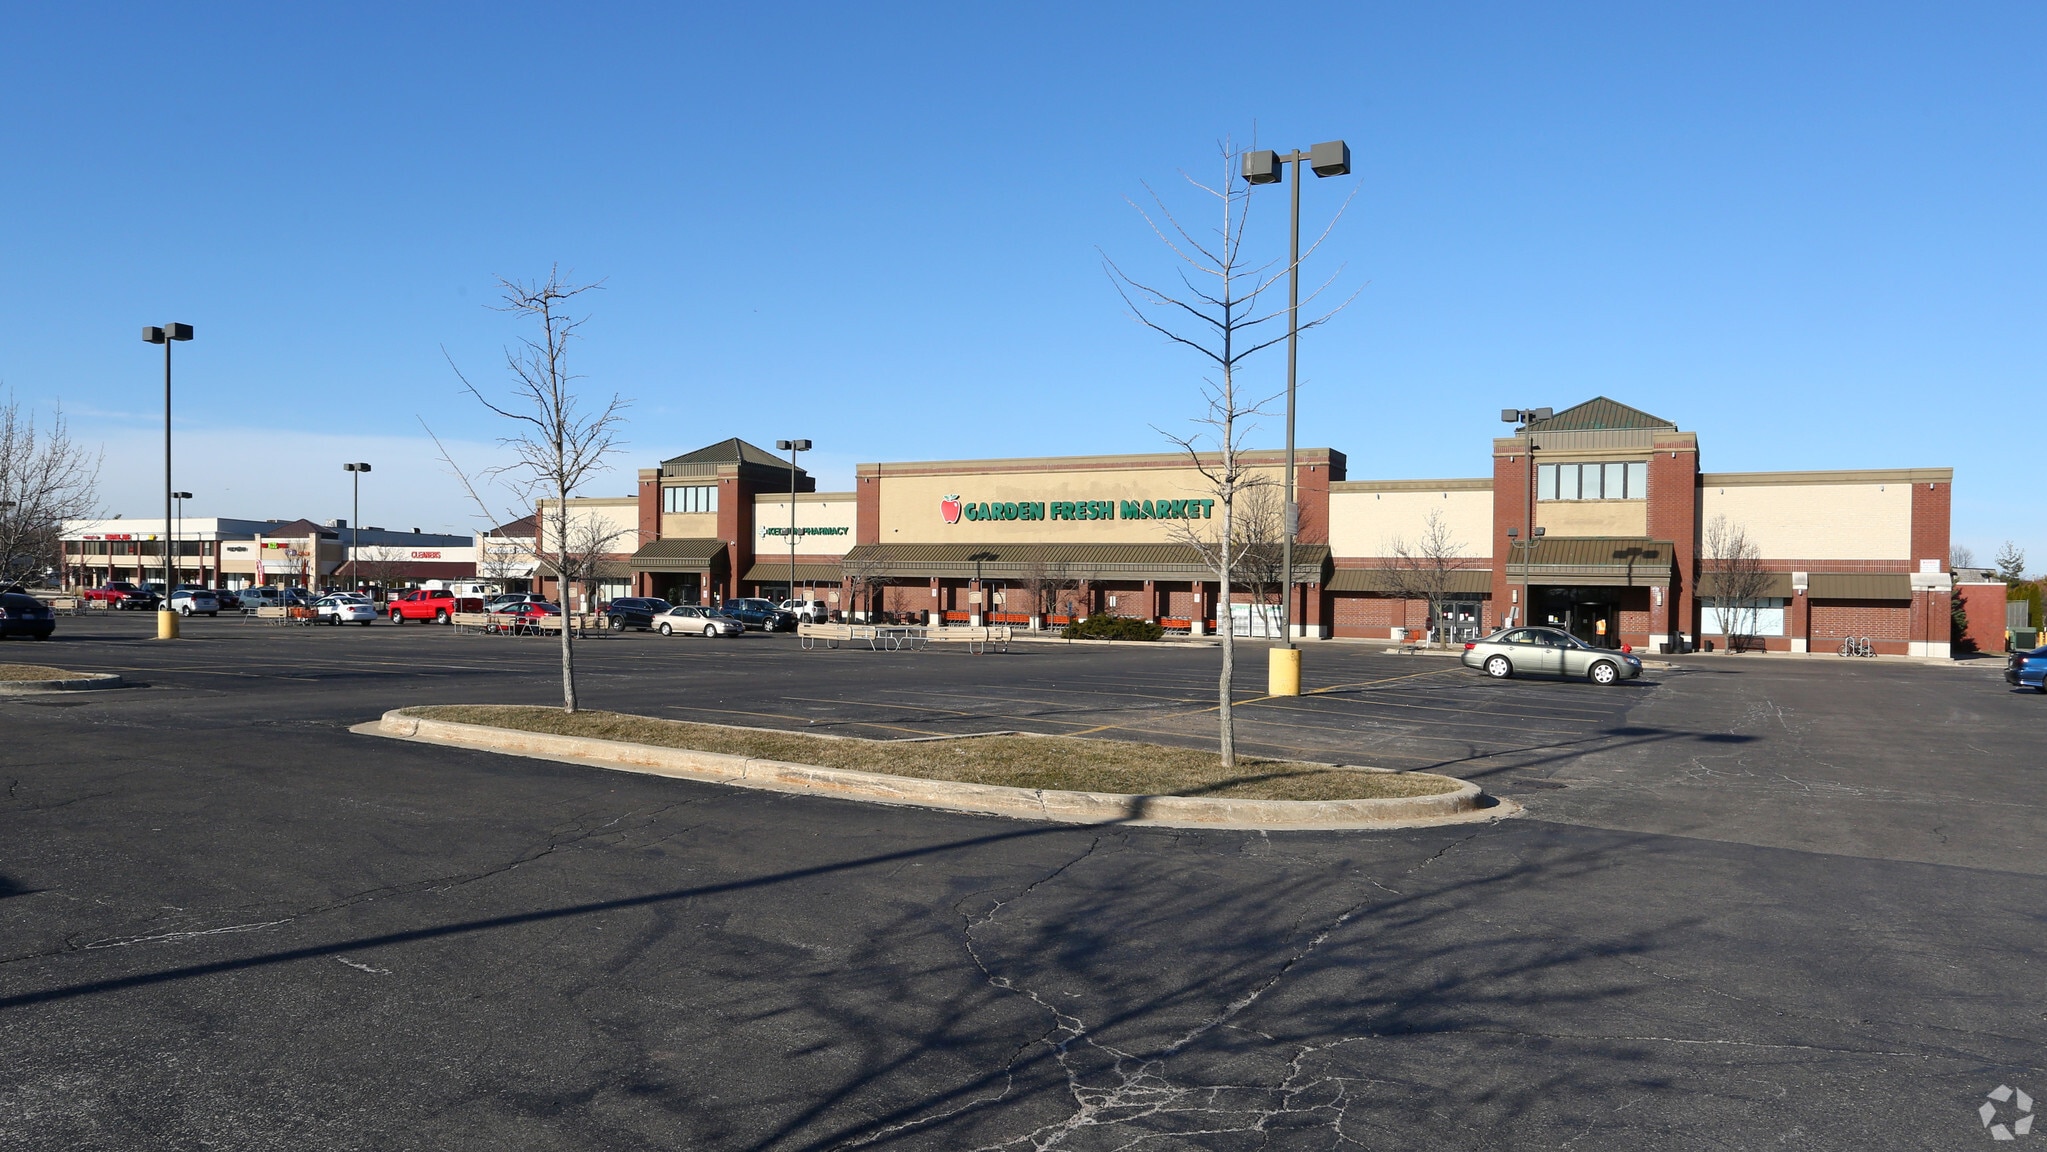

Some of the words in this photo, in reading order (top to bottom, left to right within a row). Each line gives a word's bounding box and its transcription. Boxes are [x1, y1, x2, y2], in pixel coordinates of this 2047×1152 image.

[963, 501, 1045, 521] GARDEN
[1050, 500, 1115, 521] FRESH
[1119, 498, 1215, 520] MARKET
[803, 526, 849, 536] PHARMACY
[411, 551, 442, 559] CLEANERS
